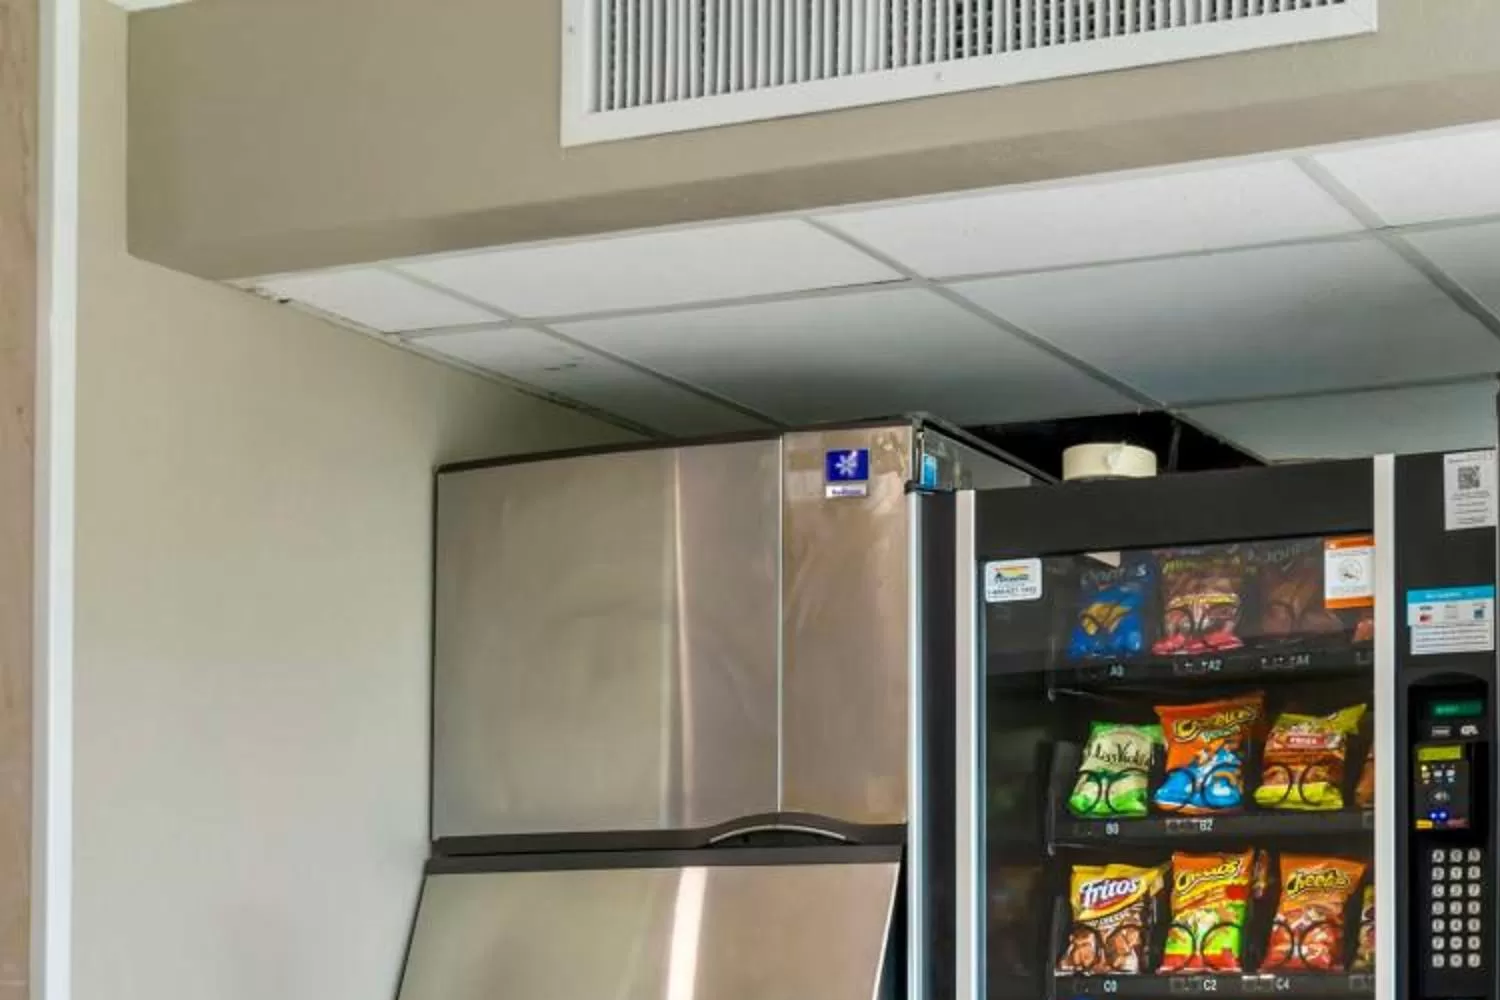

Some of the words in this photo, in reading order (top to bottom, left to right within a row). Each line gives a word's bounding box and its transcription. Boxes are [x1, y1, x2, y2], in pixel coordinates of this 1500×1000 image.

[1079, 878, 1142, 909] Fritos
[1203, 979, 1217, 991] C2
[1275, 978, 1290, 991] C4
